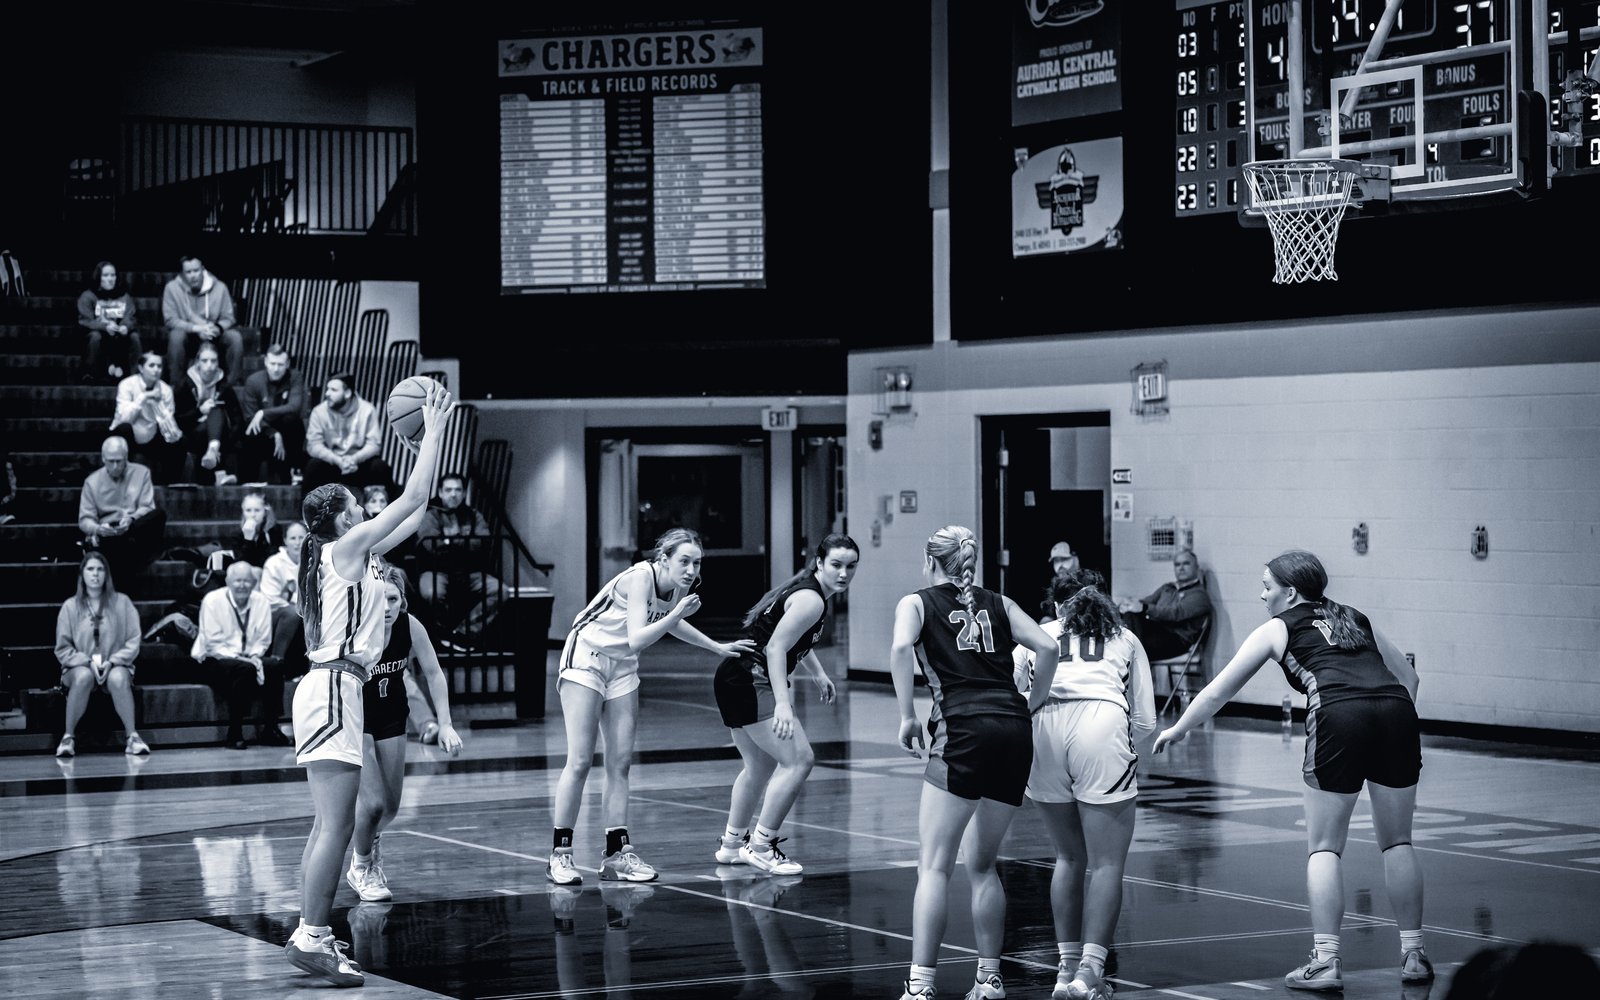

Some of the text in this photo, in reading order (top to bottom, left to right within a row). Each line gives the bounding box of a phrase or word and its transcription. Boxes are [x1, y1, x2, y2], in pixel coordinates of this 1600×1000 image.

[1183, 11, 1196, 27] NO
[1210, 7, 1216, 22] F
[1453, 0, 1494, 48] 37
[541, 33, 716, 71] CHARGERS
[1178, 32, 1197, 57] 03
[1017, 49, 1117, 83] AURORA CENTRAL
[1436, 63, 1476, 86] BONUS
[542, 73, 718, 96] TRACK & FIELD RECORDS
[1017, 69, 1117, 98] CATHOLIC HIGH SCHOOL
[1178, 69, 1197, 95] 05
[1276, 88, 1312, 109] BOS
[1463, 93, 1500, 115] FOULS
[1183, 108, 1197, 132] 10
[1178, 146, 1197, 171] 22
[1427, 143, 1438, 161] 4
[1426, 165, 1448, 183] TOL
[1178, 184, 1197, 209] 25
[1142, 375, 1159, 399] EXIT
[769, 410, 790, 427] EXIT
[948, 609, 995, 652] 21
[1056, 630, 1105, 662] 10
[378, 677, 389, 697] 1
